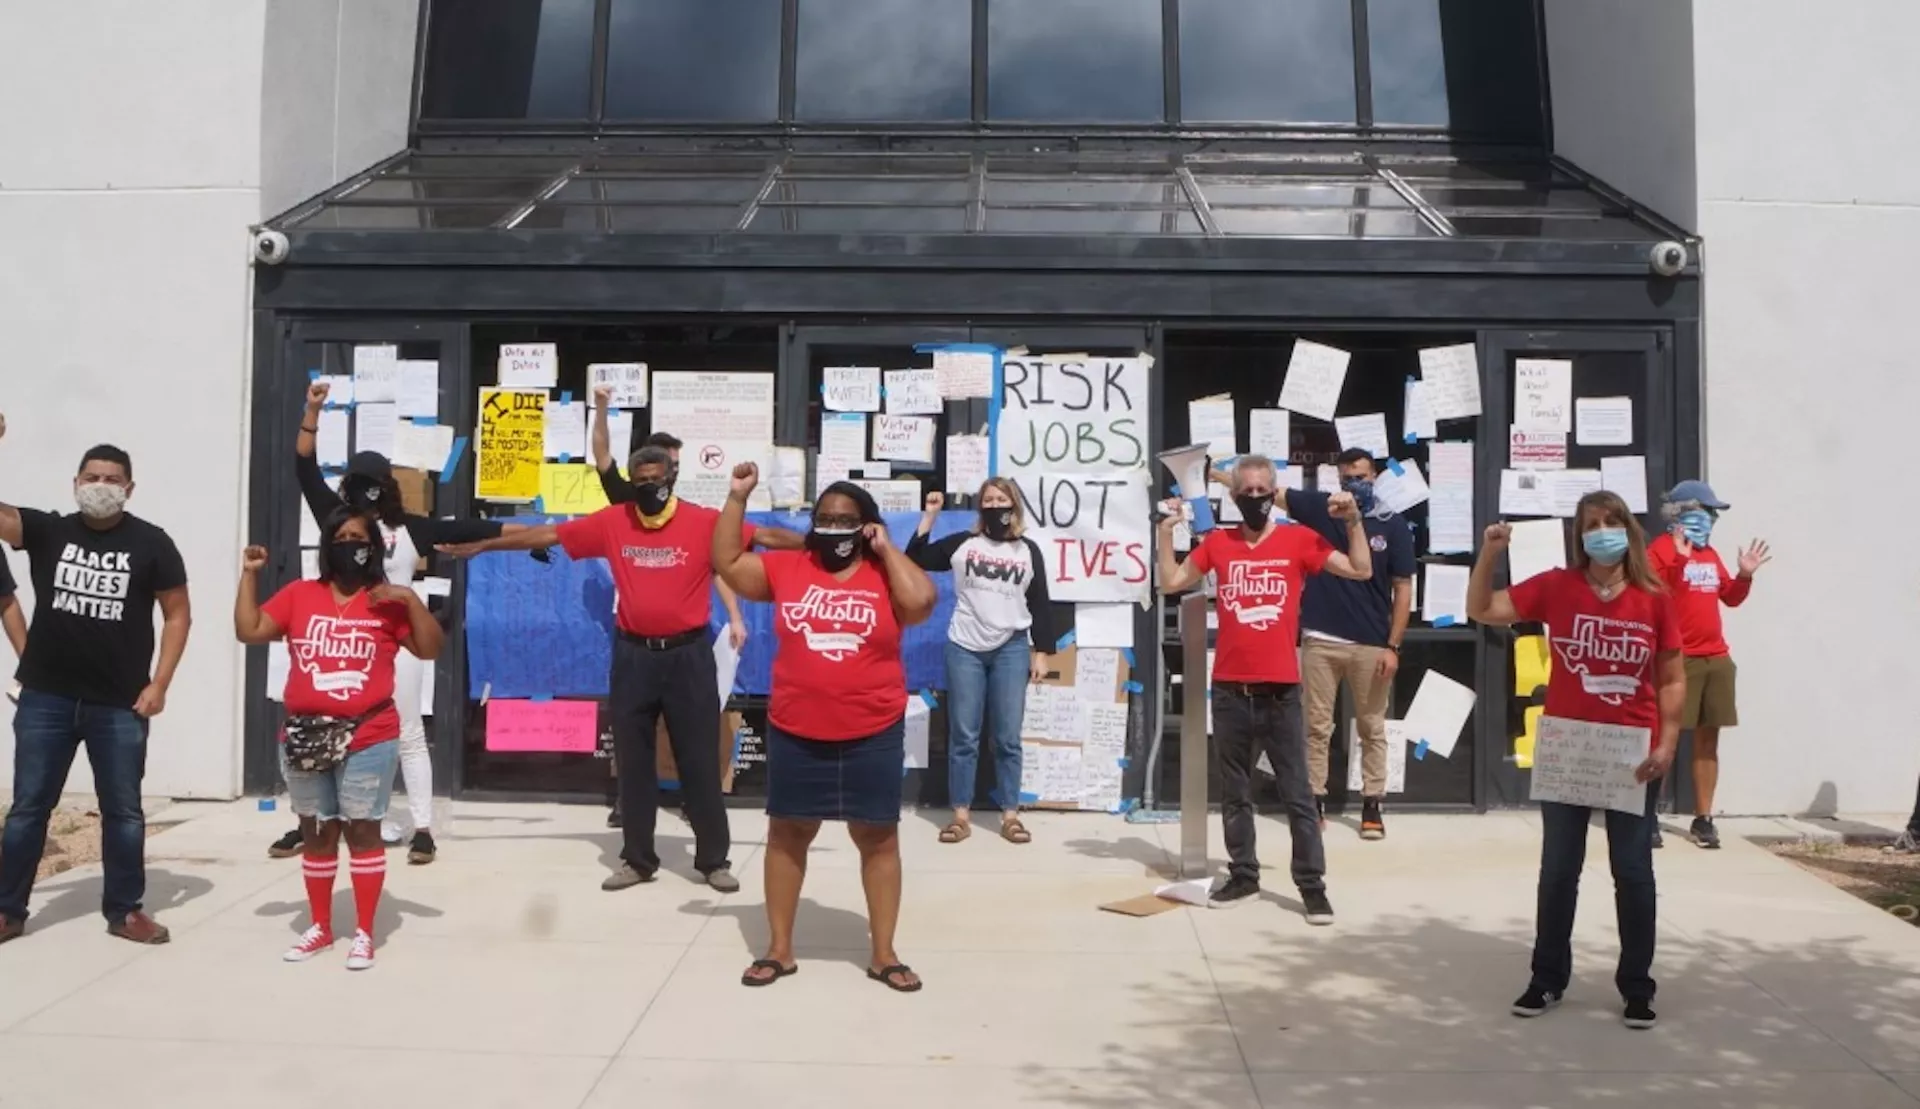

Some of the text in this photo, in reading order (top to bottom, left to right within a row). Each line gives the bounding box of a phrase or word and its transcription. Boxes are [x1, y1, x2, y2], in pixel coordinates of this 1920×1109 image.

[514, 392, 545, 411] DIE
[1002, 360, 1132, 412] RISK
[1009, 419, 1146, 468] JOBS,
[1010, 476, 1128, 528] NOT
[61, 542, 131, 571] BLACK
[1054, 538, 1148, 583] IVES
[61, 567, 121, 594] LIVES
[1220, 566, 1288, 600] Austin
[52, 590, 125, 621] MATTER
[782, 591, 877, 626] Austin
[292, 621, 377, 661] Austin
[1552, 621, 1651, 664] Austin
